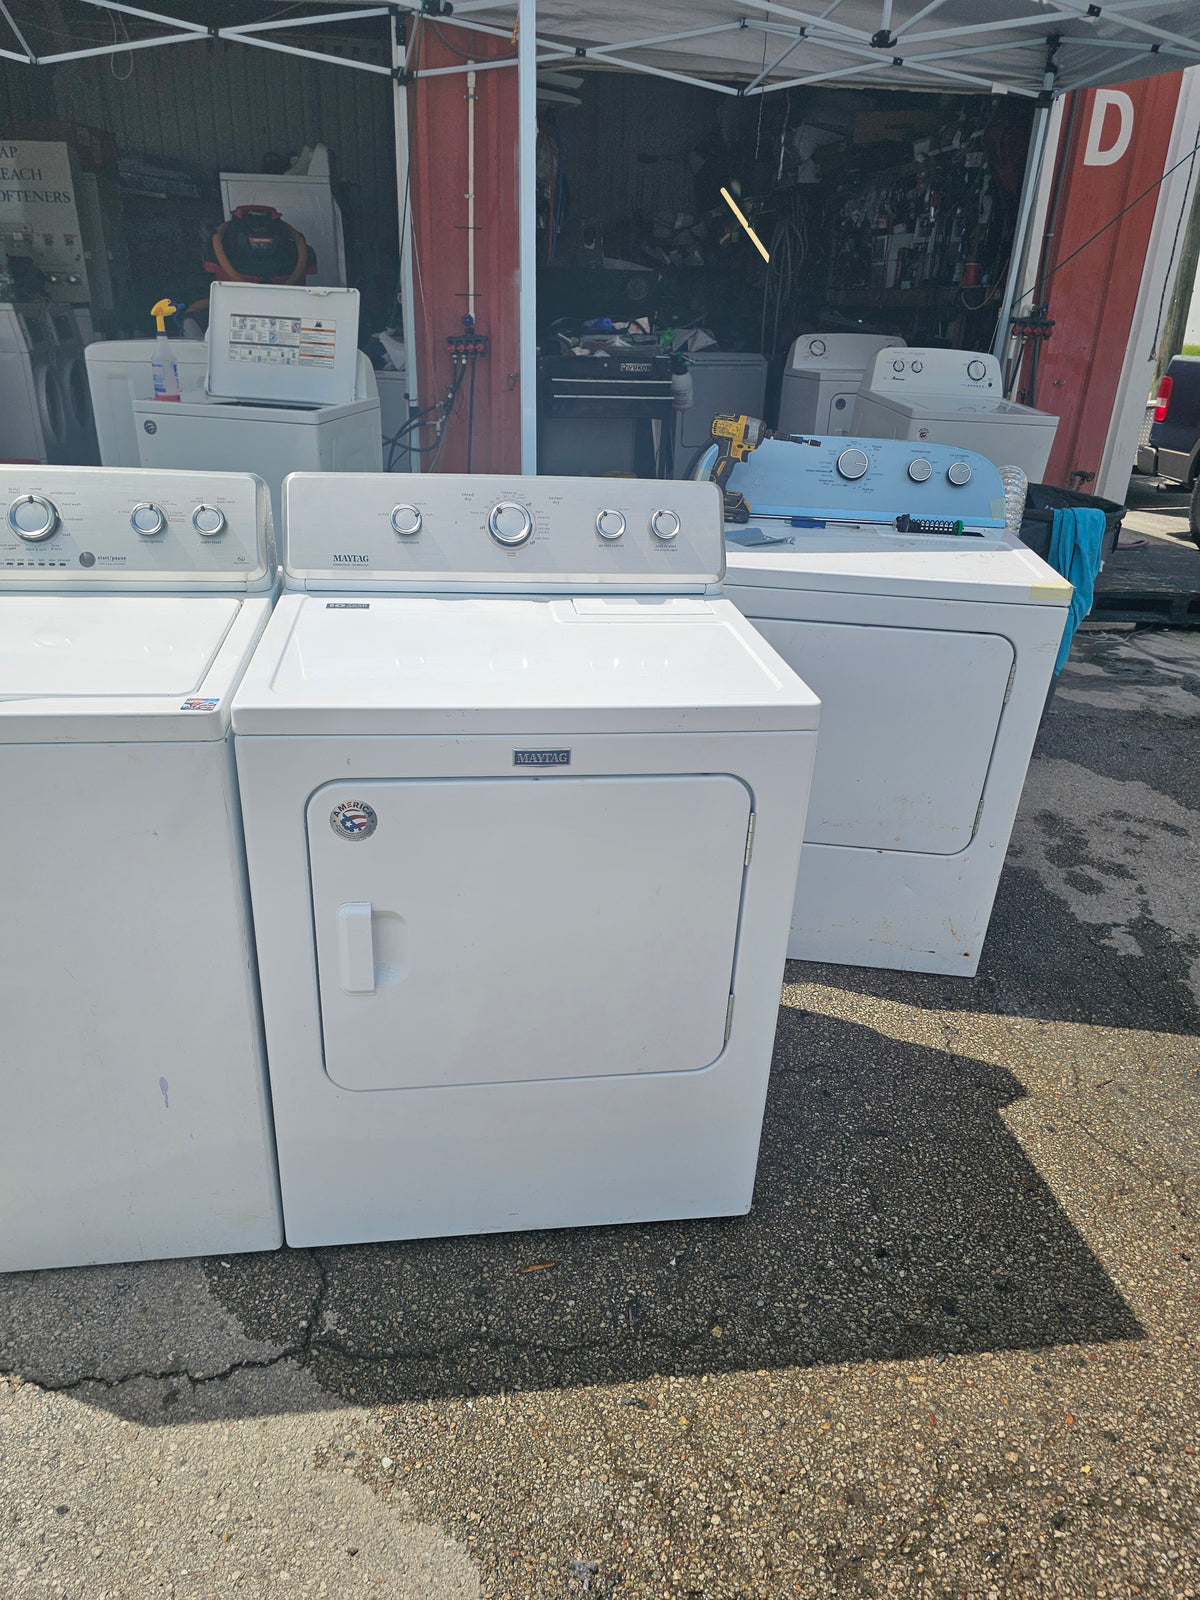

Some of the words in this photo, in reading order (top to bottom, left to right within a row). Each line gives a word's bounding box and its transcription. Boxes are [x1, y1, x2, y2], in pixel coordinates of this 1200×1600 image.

[1083, 88, 1135, 167] D
[0, 167, 43, 181] EACH
[333, 554, 369, 563] MAYTAG
[517, 753, 567, 763] MAYTAG
[333, 801, 373, 818] AMERICA
